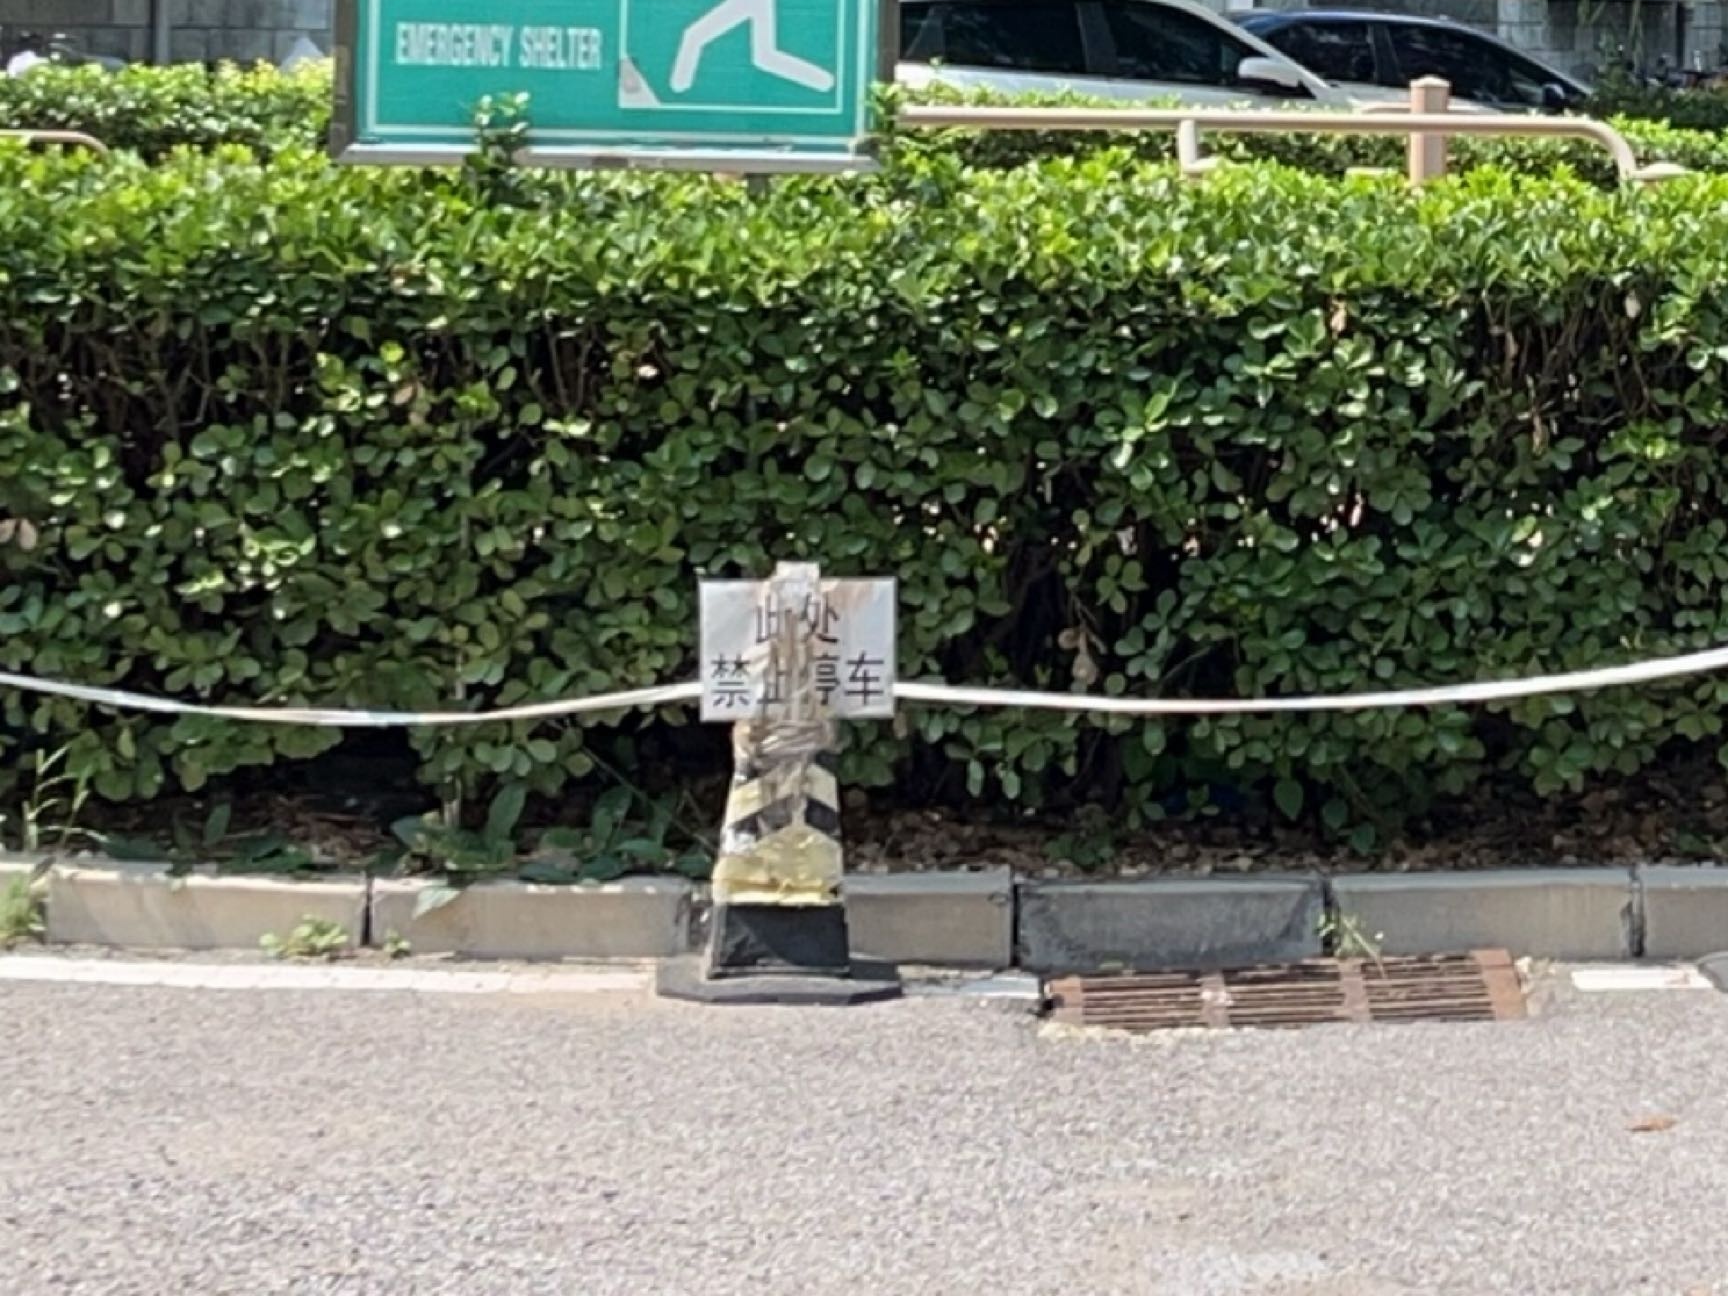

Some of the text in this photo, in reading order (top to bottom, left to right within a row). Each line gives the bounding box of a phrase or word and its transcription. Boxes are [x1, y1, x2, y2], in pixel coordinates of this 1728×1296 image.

[396, 23, 602, 69] EMERGENCY SHELTER
[755, 591, 841, 644] 此处
[710, 650, 884, 708] 禁止停车
